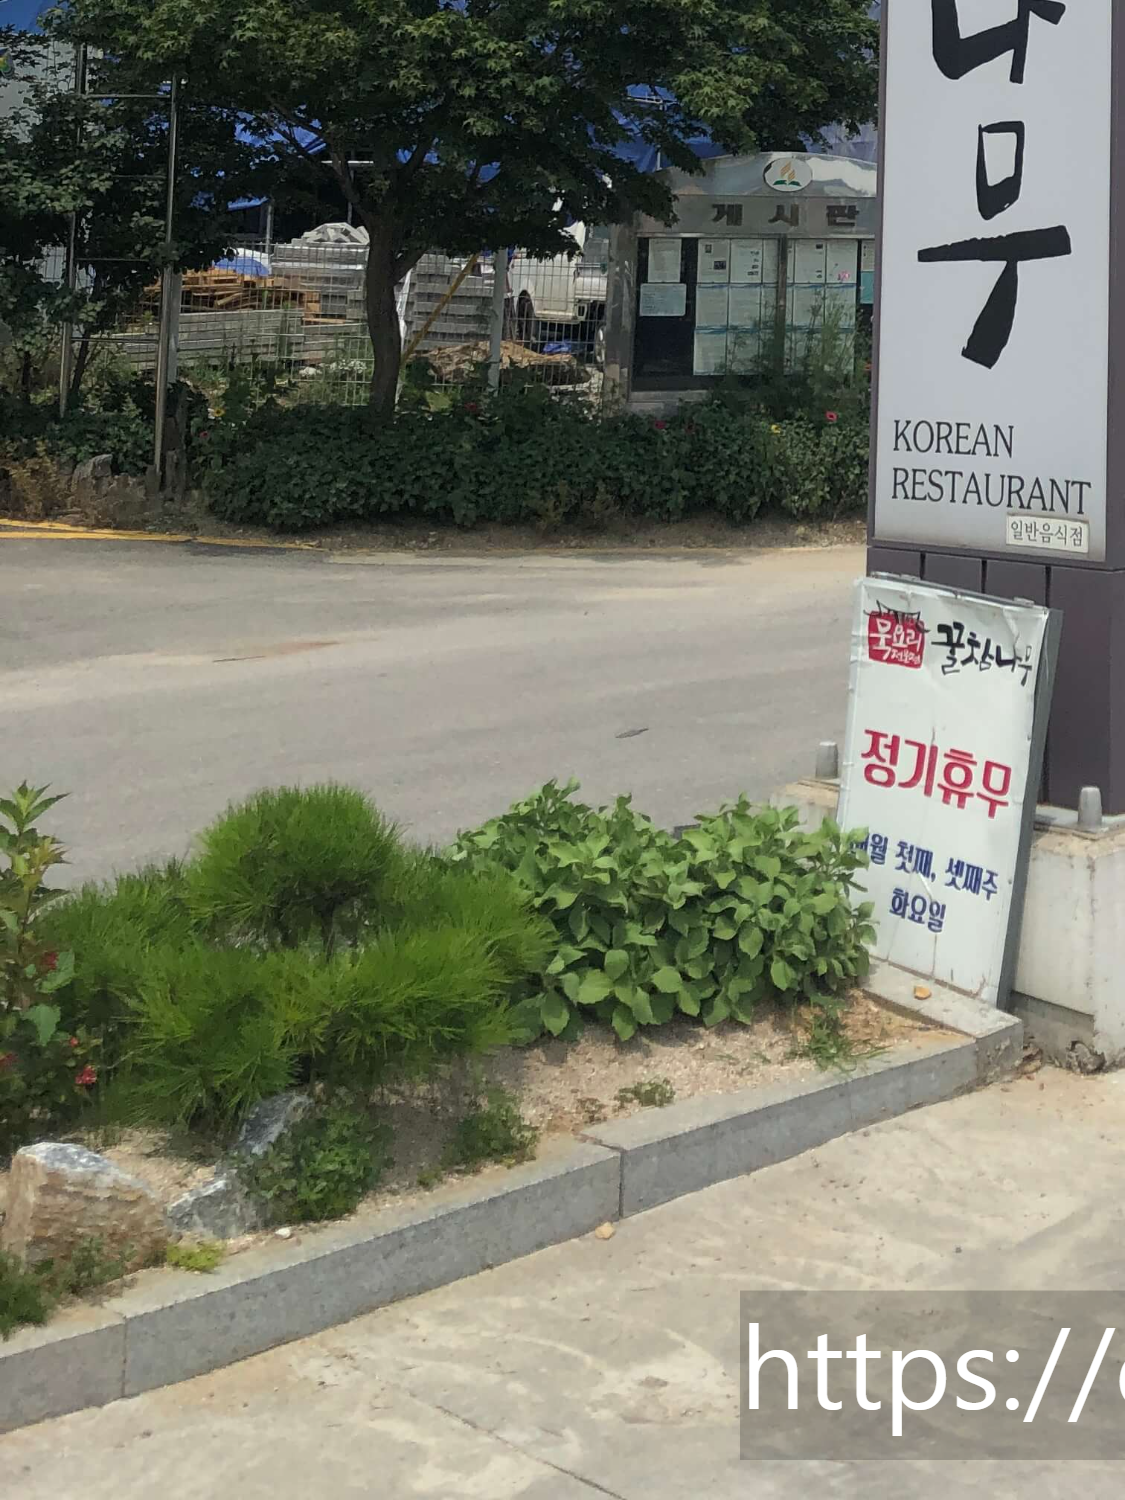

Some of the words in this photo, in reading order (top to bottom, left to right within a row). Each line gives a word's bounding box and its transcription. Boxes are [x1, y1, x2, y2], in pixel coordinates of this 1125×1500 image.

[711, 203, 860, 227] 게시판
[893, 419, 1014, 459] KOREAN
[891, 467, 1092, 515] RESTAURANT
[1010, 519, 1084, 548] 일반음식점
[931, 621, 1033, 687] 꿀참나무
[860, 729, 1012, 819] 정기휴무
[895, 840, 937, 883] 첫째,
[944, 857, 999, 901] 셋째주
[889, 887, 947, 934] 화요일
